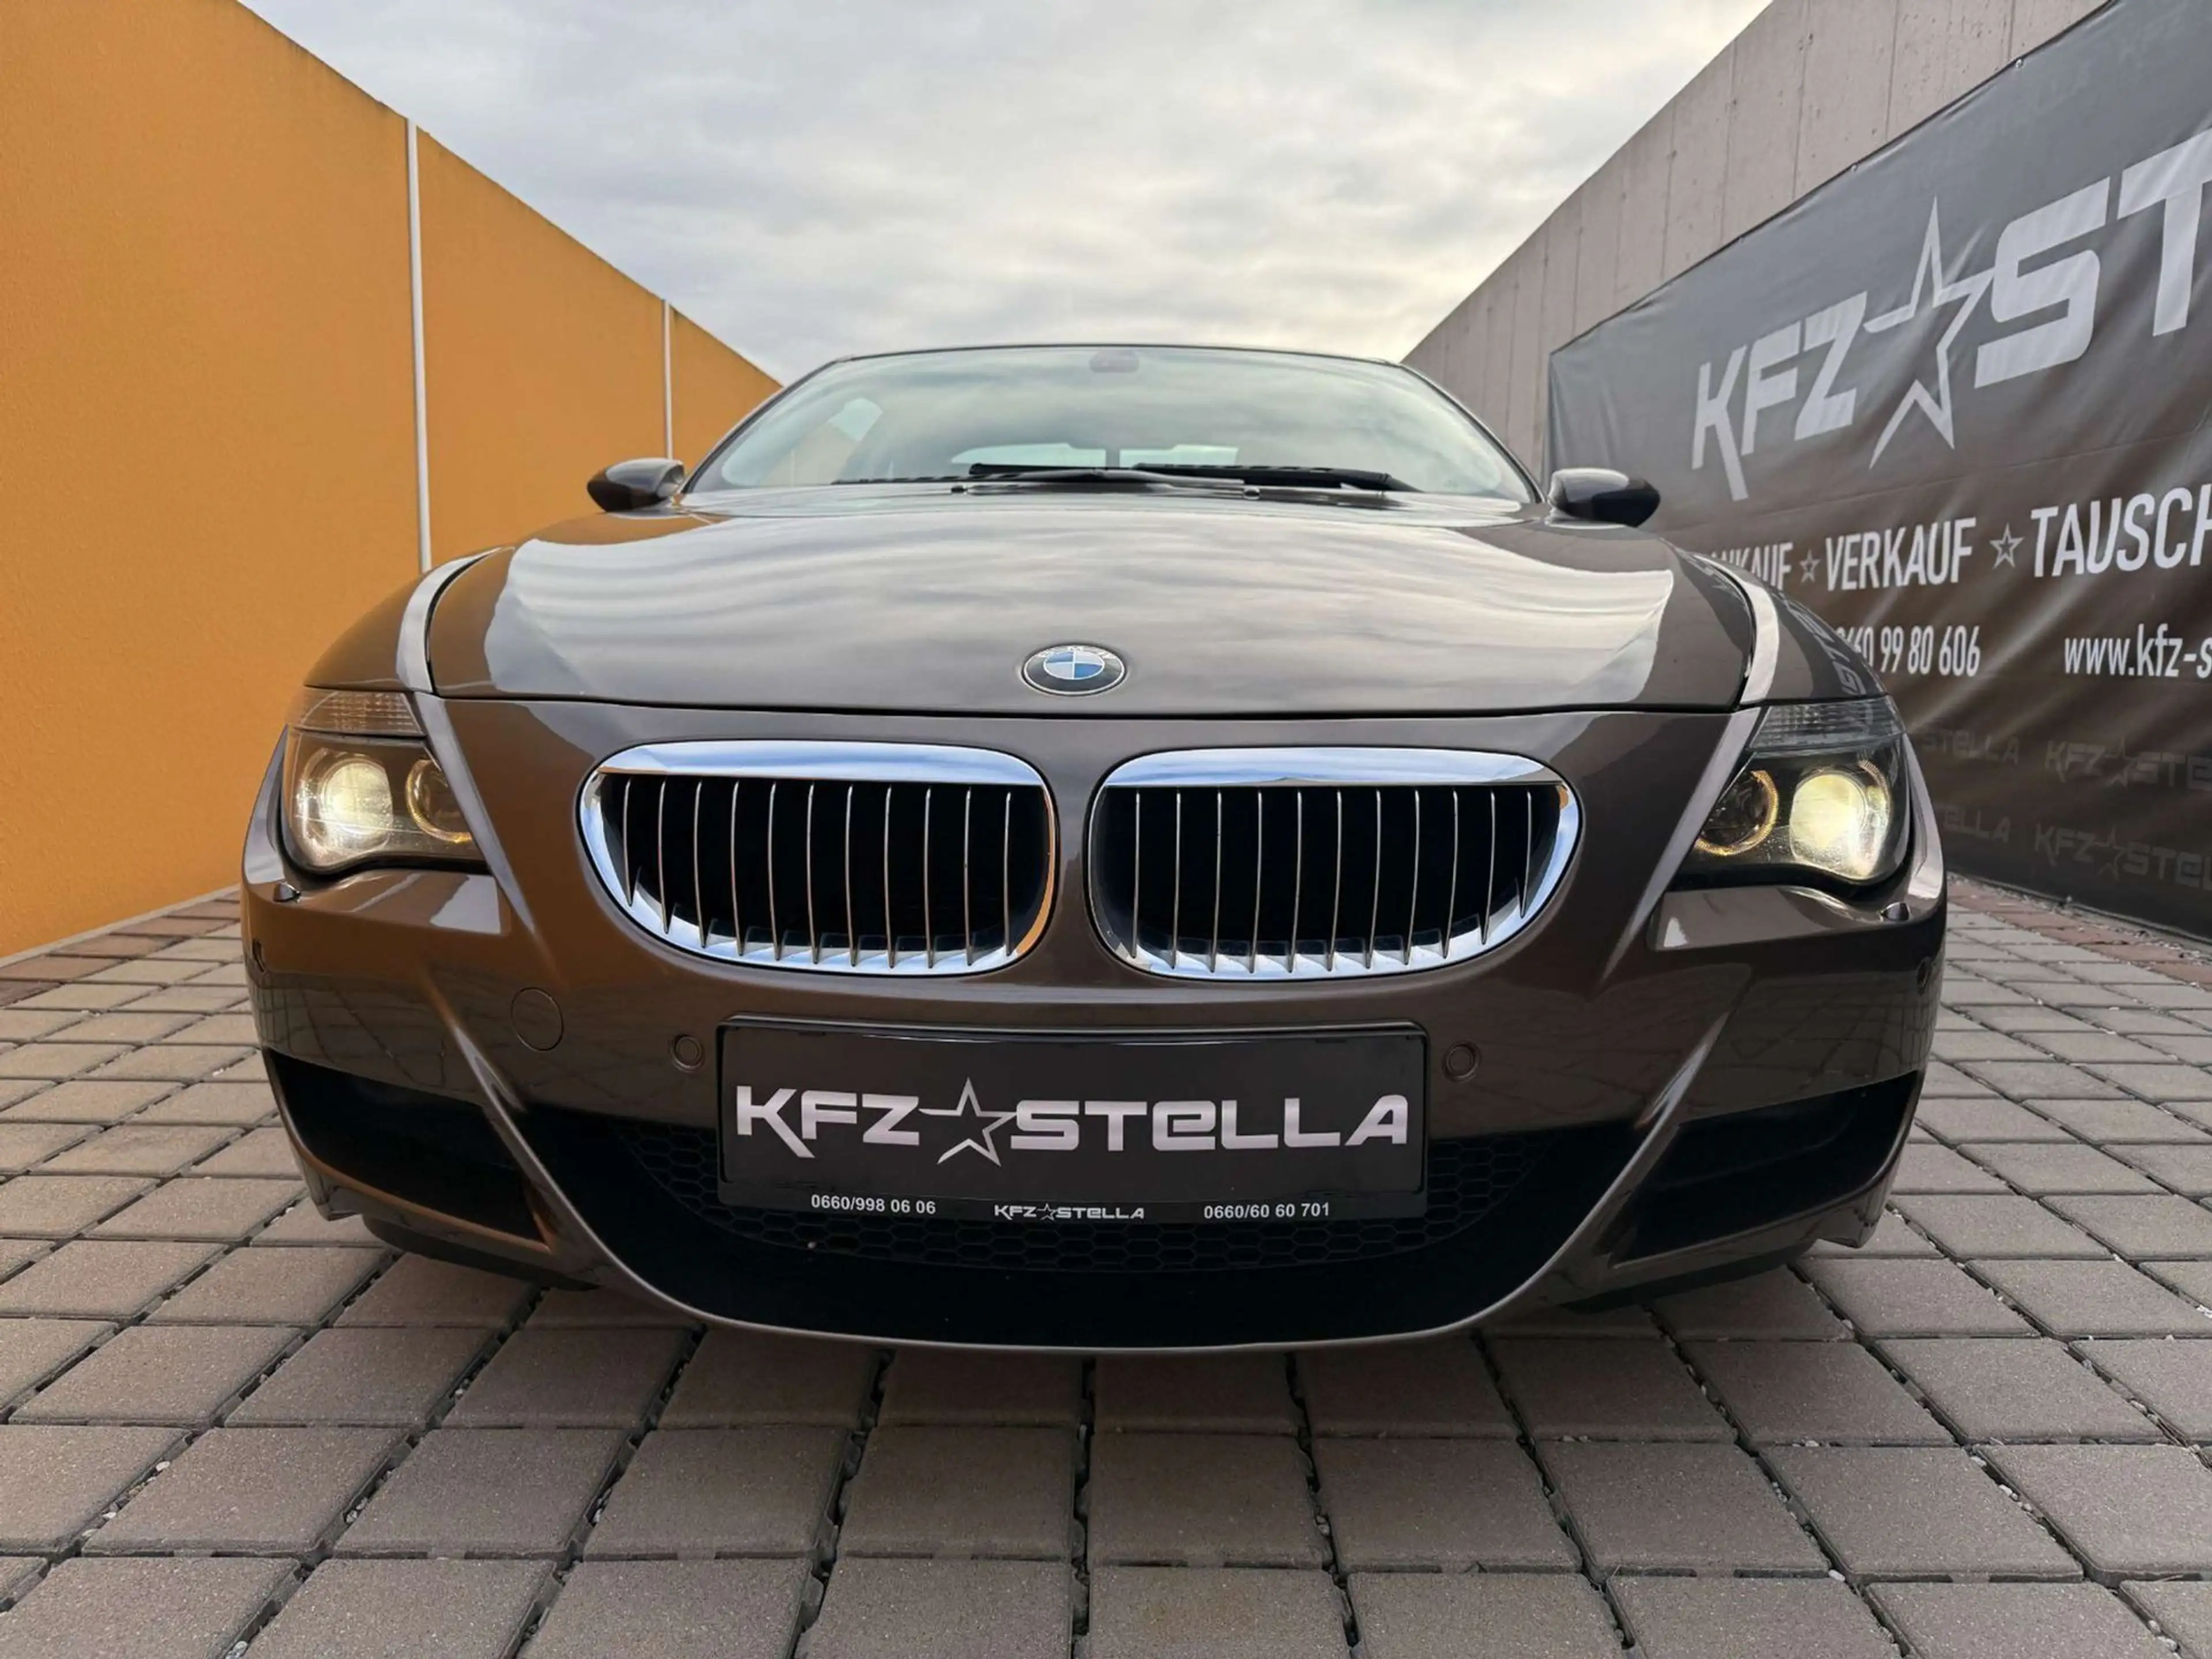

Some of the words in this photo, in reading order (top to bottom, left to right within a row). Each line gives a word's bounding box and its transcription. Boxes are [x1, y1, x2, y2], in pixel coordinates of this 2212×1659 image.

[1691, 291, 1868, 502] KFZ
[1825, 517, 1977, 592] VERKAUF
[1880, 624, 1904, 674] 99
[1908, 624, 1934, 676] 80
[1938, 624, 1982, 678] 606
[2044, 740, 2106, 783] KFZ
[2035, 822, 2097, 868] KFZ
[736, 1085, 920, 1158] KFZ
[1010, 1094, 1408, 1152] STELLA
[810, 1194, 885, 1212] 0660/998
[890, 1199, 910, 1214] 06
[915, 1200, 936, 1215] 06
[994, 1204, 1037, 1221] KFZ
[1056, 1207, 1145, 1219] STELLA
[1203, 1204, 1270, 1219] 0660/60
[1275, 1203, 1296, 1217] 60
[1301, 1202, 1330, 1217] 701
